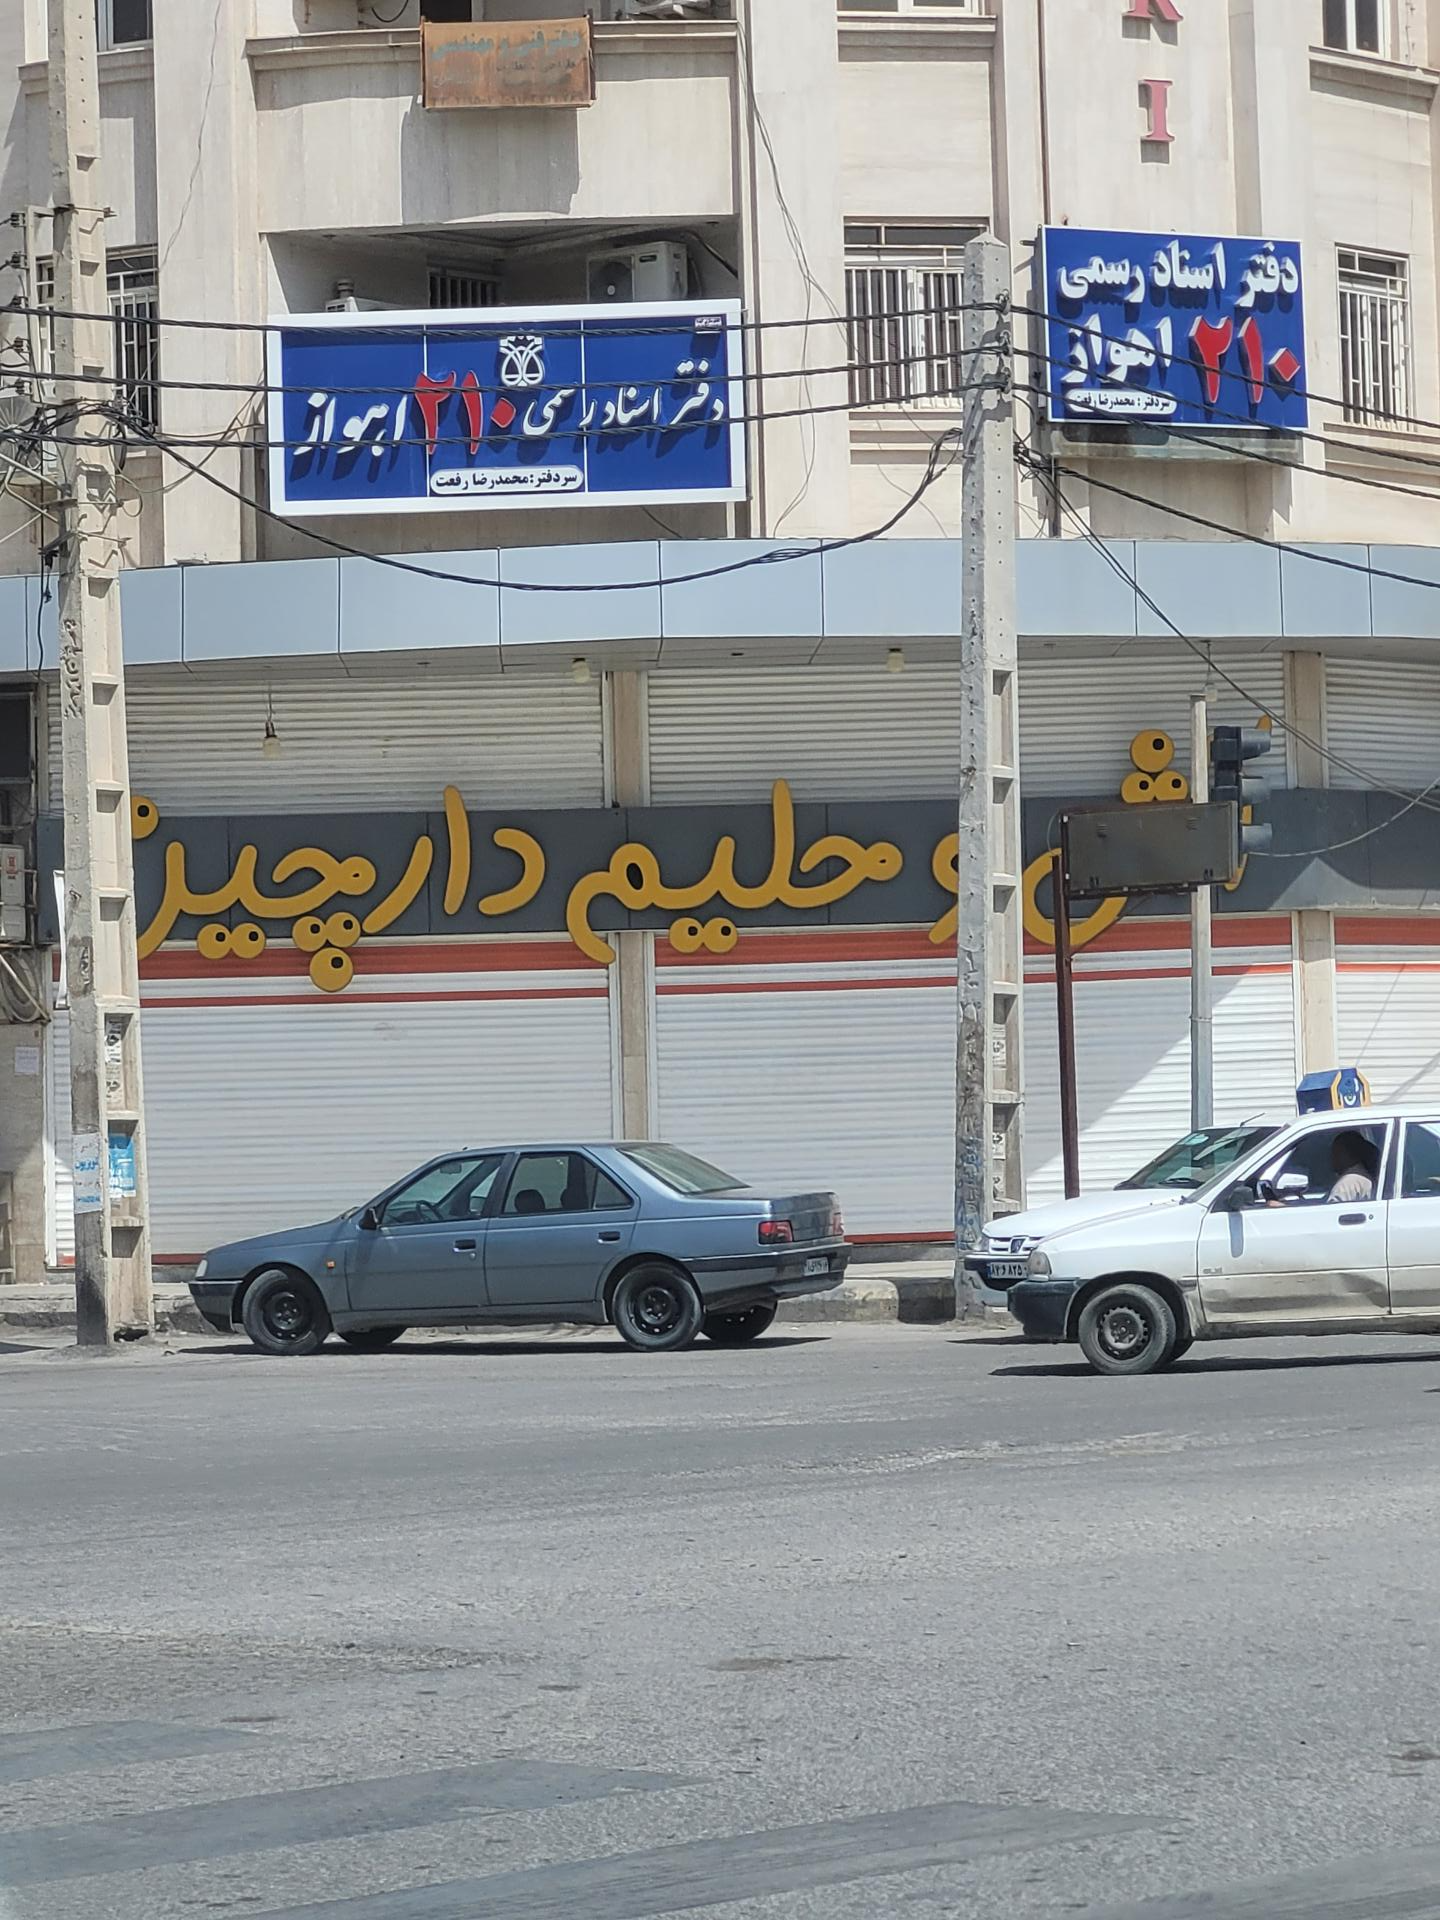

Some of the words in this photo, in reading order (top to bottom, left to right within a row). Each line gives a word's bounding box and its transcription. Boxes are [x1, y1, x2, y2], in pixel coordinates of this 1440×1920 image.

[1057, 255, 1146, 303] رسمی
[1150, 239, 1227, 290] اسناد
[1234, 241, 1299, 307] دفتر
[1060, 312, 1174, 384] اهواز
[1188, 315, 1301, 404] ۲۱۰
[413, 369, 517, 456] ۲۱۰
[523, 383, 597, 436] رسمی
[602, 384, 661, 427] اسناد
[670, 357, 725, 427] دفتر
[1076, 391, 1097, 408] رفعت
[1098, 392, 1135, 410] محمدرضا
[292, 390, 408, 457] اهواز
[435, 472, 468, 490] رفعت
[472, 472, 529, 489] محمدرضا
[566, 778, 904, 964] حلیم
